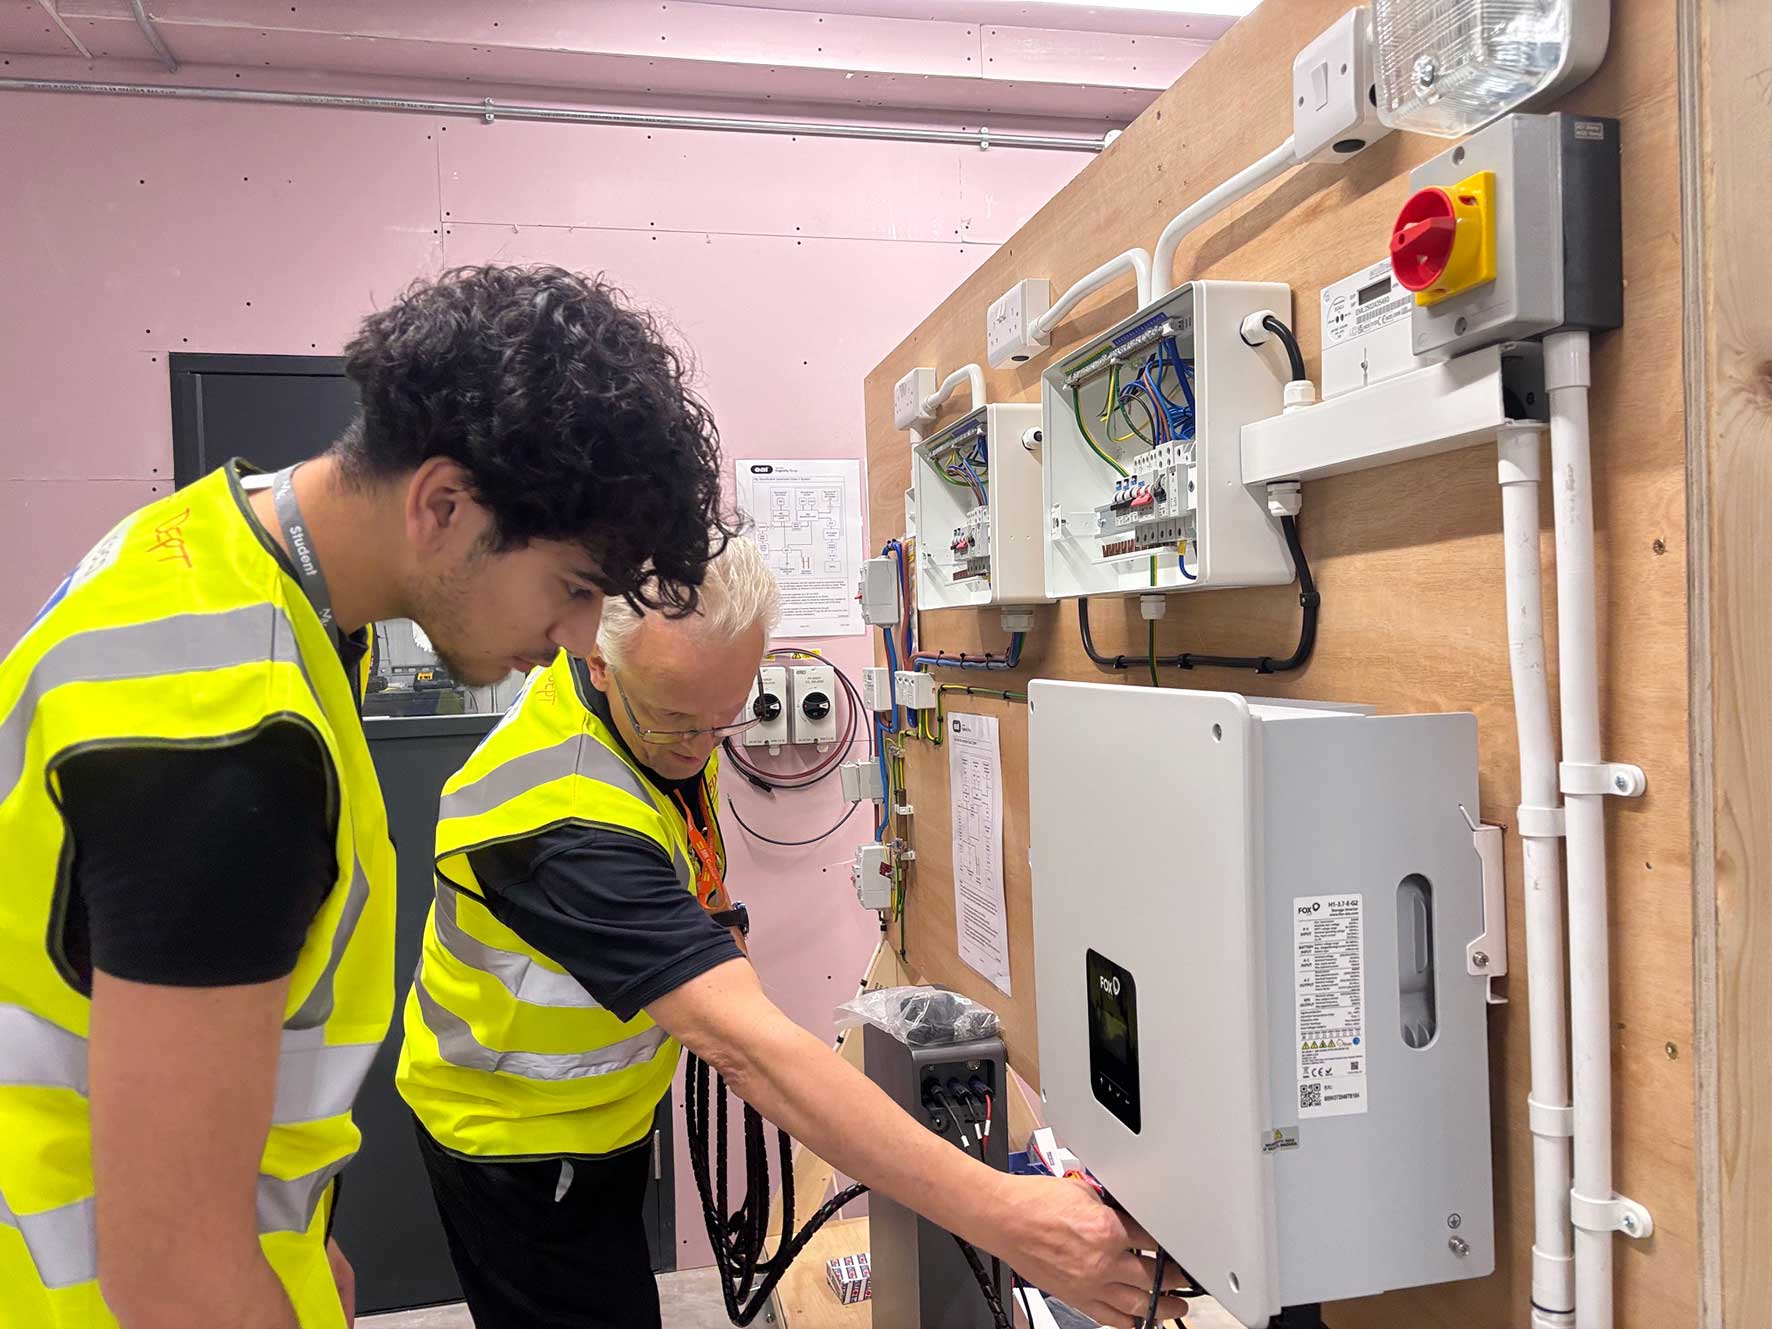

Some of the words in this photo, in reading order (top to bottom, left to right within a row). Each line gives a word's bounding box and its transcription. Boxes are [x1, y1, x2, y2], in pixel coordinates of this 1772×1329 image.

[289, 525, 318, 577] Student
[1298, 906, 1312, 915] FOX
[1100, 975, 1113, 995] FOX
